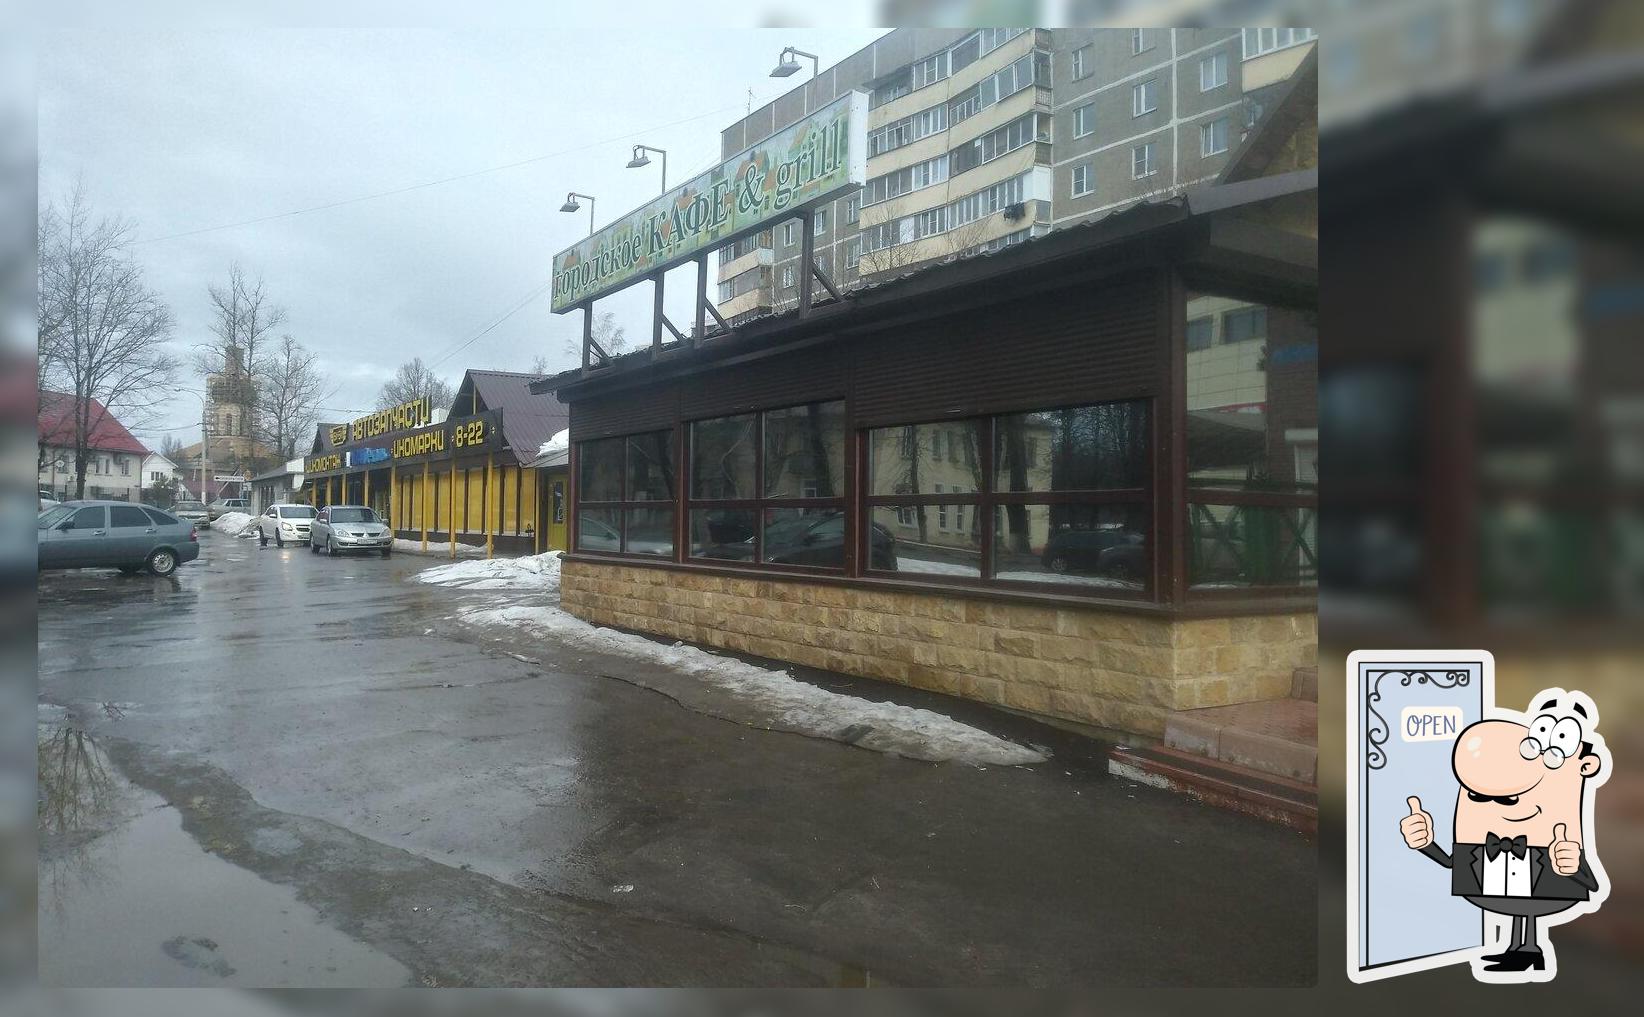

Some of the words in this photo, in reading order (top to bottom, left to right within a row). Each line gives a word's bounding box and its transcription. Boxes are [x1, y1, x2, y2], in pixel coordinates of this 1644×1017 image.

[648, 178, 733, 257] КАФЕ
[739, 163, 767, 214] &
[774, 118, 843, 210] grill
[393, 429, 445, 459] ИНОМАРКИ
[456, 420, 484, 448] 8-22
